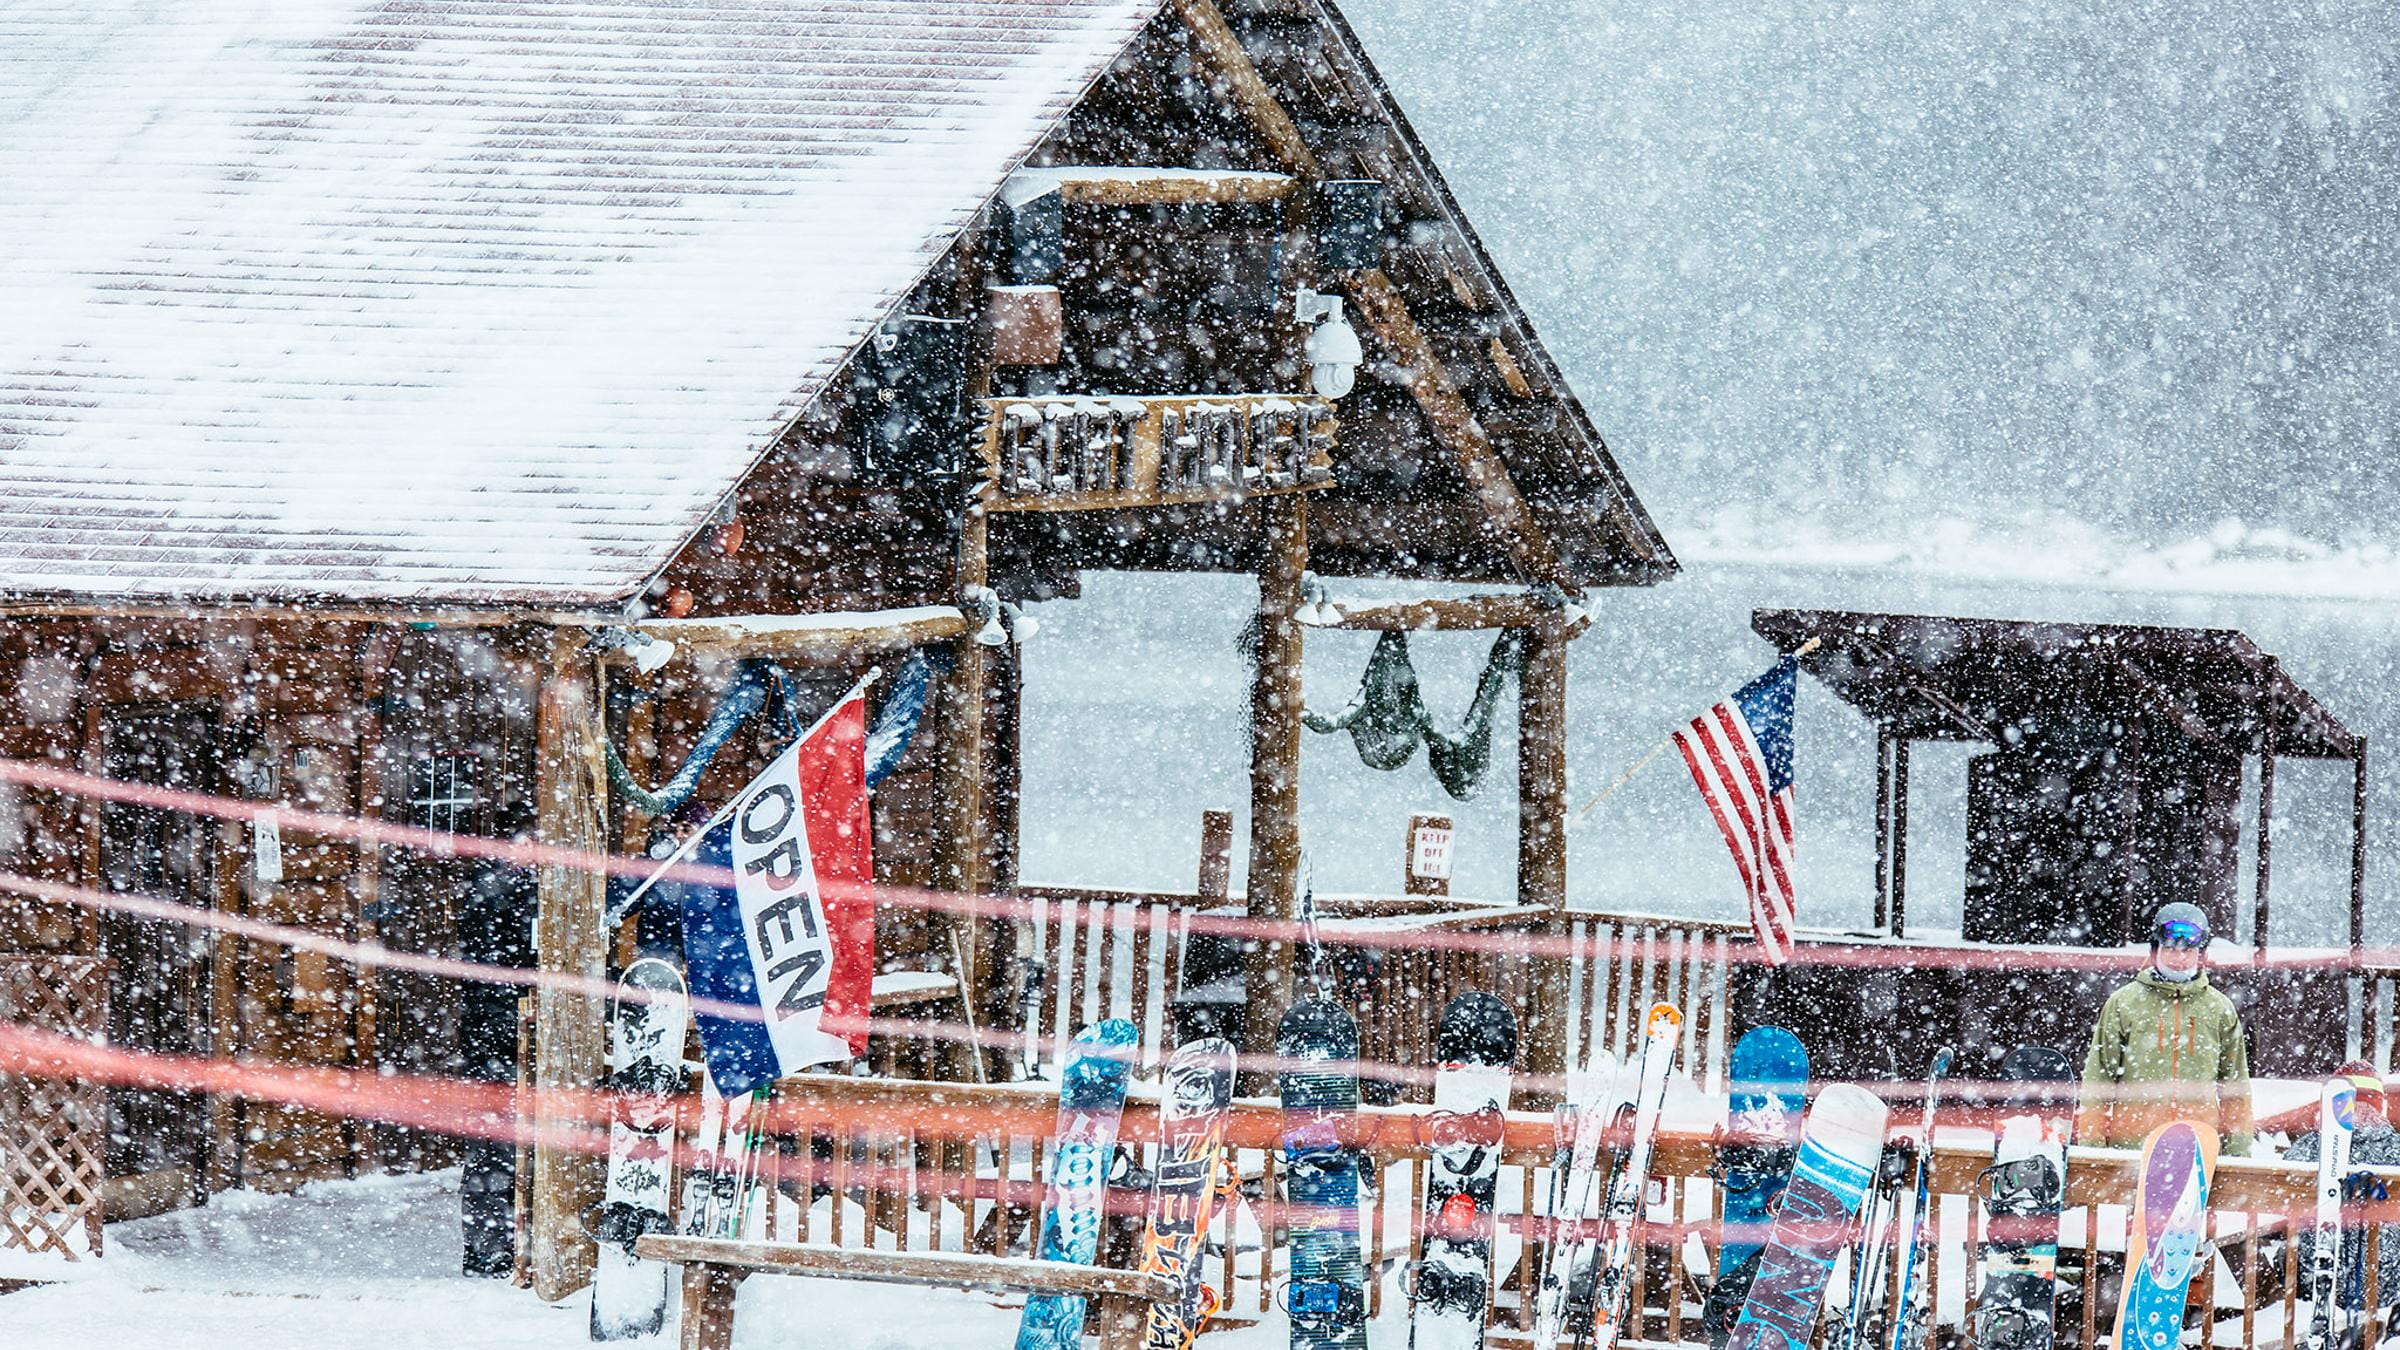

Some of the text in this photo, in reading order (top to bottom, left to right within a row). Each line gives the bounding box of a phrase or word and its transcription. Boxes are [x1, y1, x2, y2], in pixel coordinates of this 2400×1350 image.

[1424, 848, 1443, 857] OFF
[741, 783, 827, 1022] OPEN
[1155, 1109, 1219, 1238] LIB
[2331, 1134, 2339, 1177] DYNASTAR
